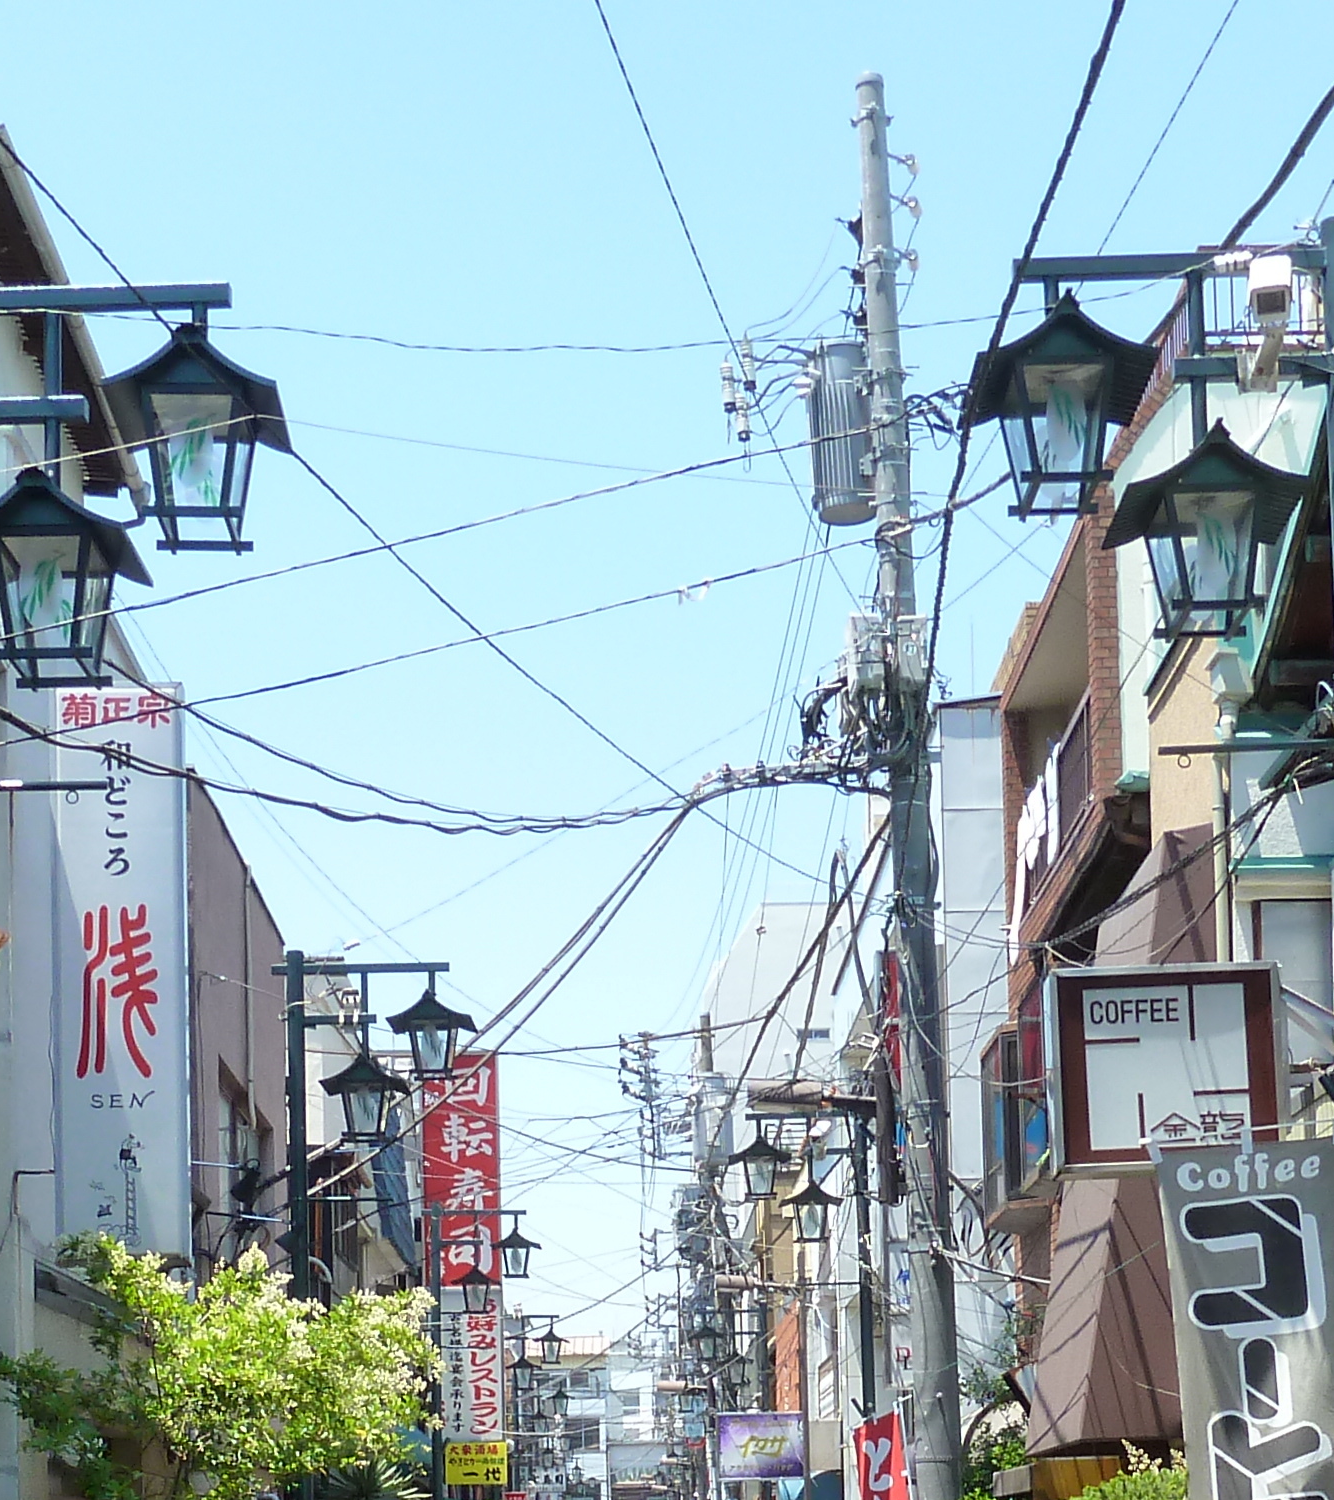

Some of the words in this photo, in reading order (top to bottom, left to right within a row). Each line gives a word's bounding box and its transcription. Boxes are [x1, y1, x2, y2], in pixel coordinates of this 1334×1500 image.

[62, 692, 171, 729] 菊正宗
[100, 739, 133, 877] 和どころ
[1089, 997, 1180, 1025] COFFEE
[90, 1089, 156, 1109] SEN
[439, 1064, 495, 1275] 回転寿司
[1176, 1153, 1321, 1193] Coffee
